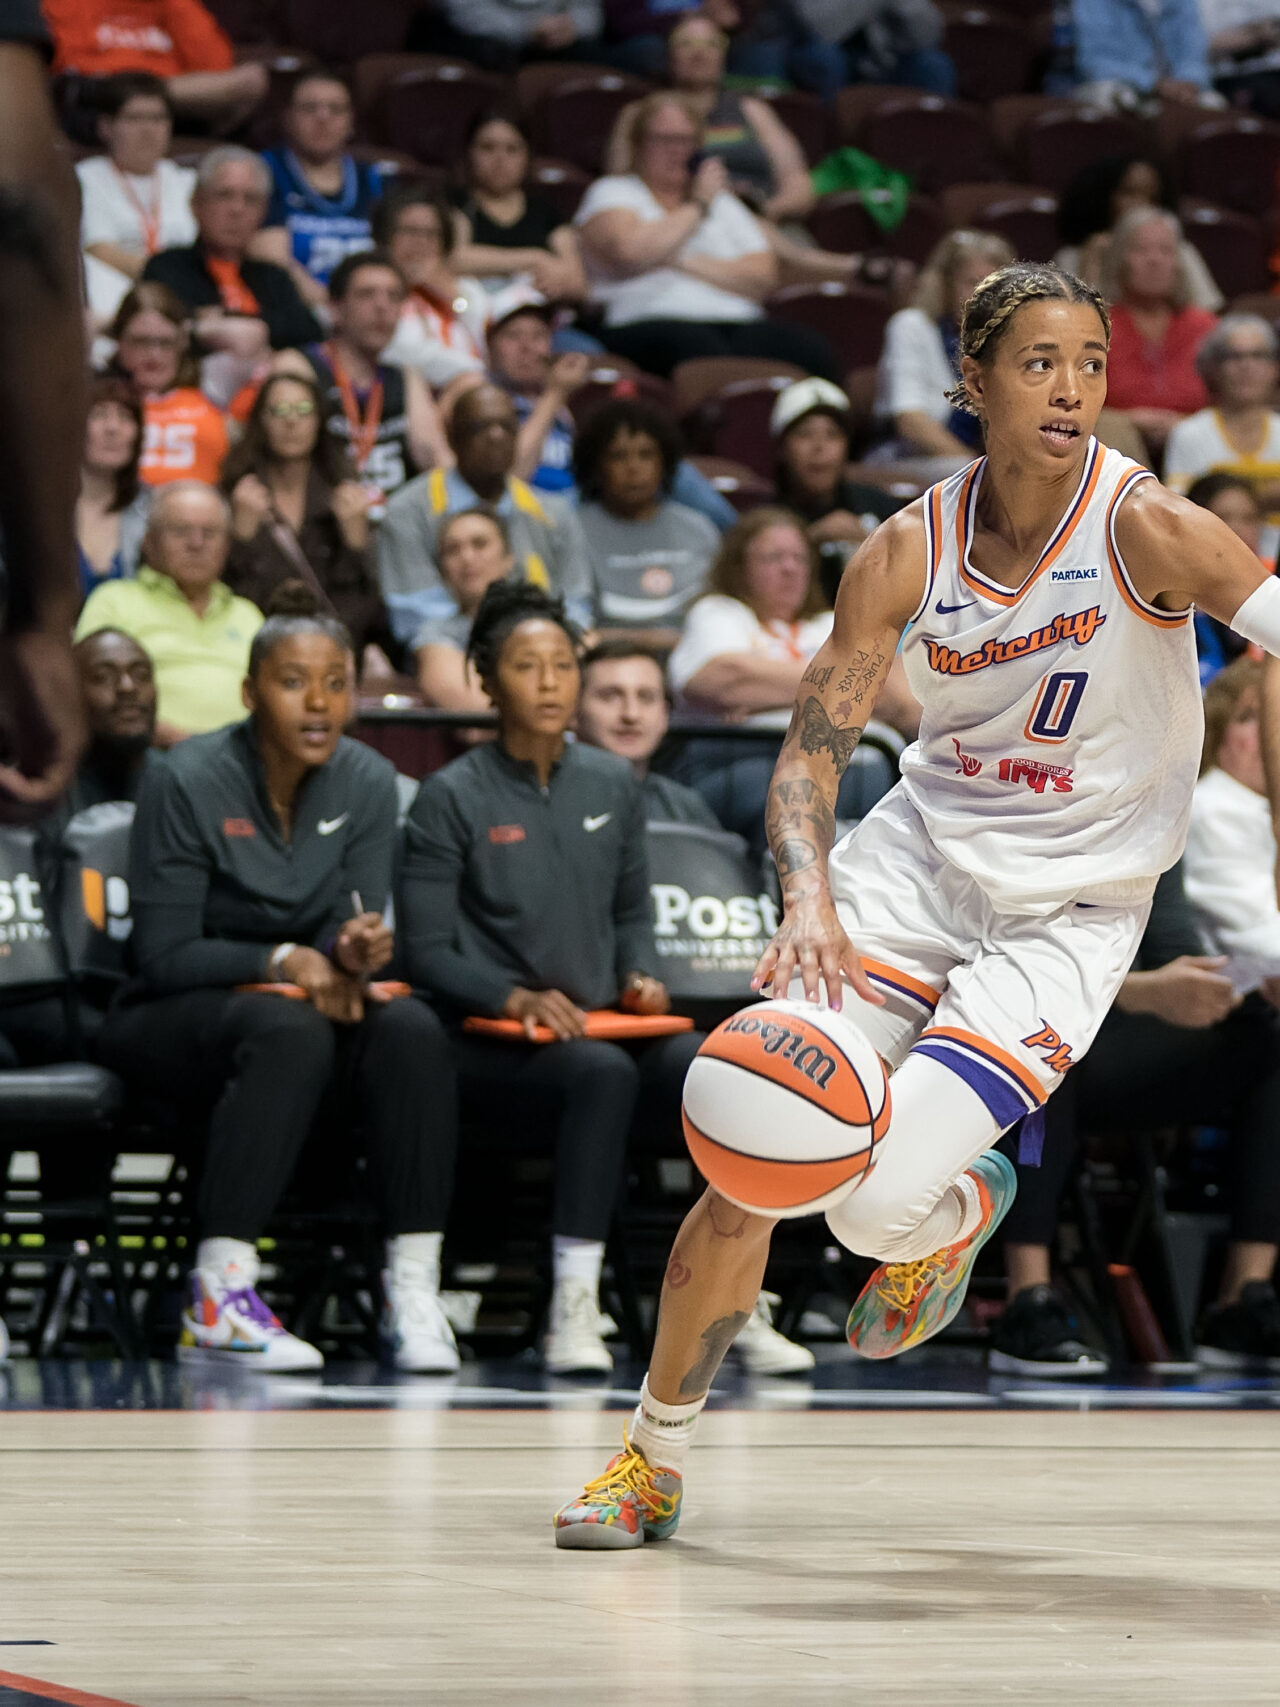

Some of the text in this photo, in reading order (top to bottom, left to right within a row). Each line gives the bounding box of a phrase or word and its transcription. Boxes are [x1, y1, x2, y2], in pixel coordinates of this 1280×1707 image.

[1051, 568, 1098, 582] PARTAKE
[922, 604, 1108, 675] Mercury
[1023, 669, 1090, 745] 0
[1037, 763, 1070, 776] STORES
[650, 883, 778, 937] Post
[722, 1015, 838, 1091] Wilson
